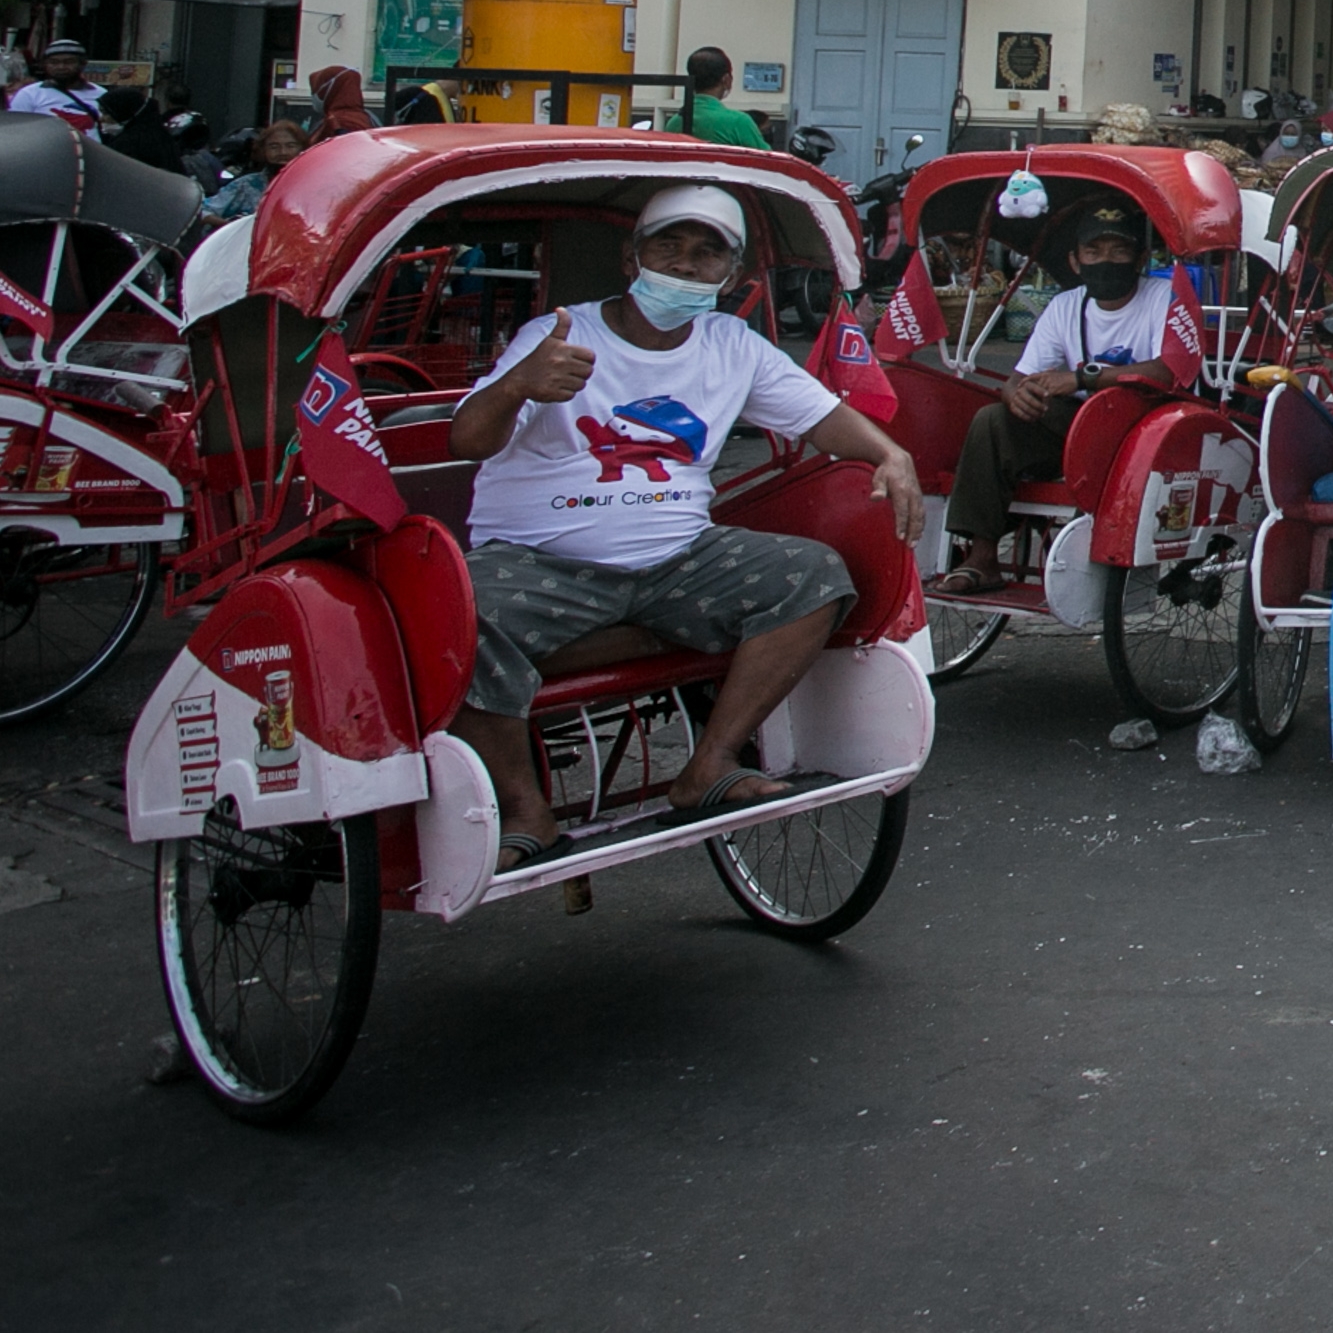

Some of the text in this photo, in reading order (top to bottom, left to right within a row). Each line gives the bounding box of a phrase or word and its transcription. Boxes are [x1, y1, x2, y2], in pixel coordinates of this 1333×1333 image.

[889, 300, 910, 341] PAINT
[896, 291, 925, 346] NIPPON
[1167, 316, 1198, 354] PAINT
[334, 417, 389, 465] PAIN
[551, 489, 692, 510] Colour Creations
[234, 649, 268, 666] NIPPON
